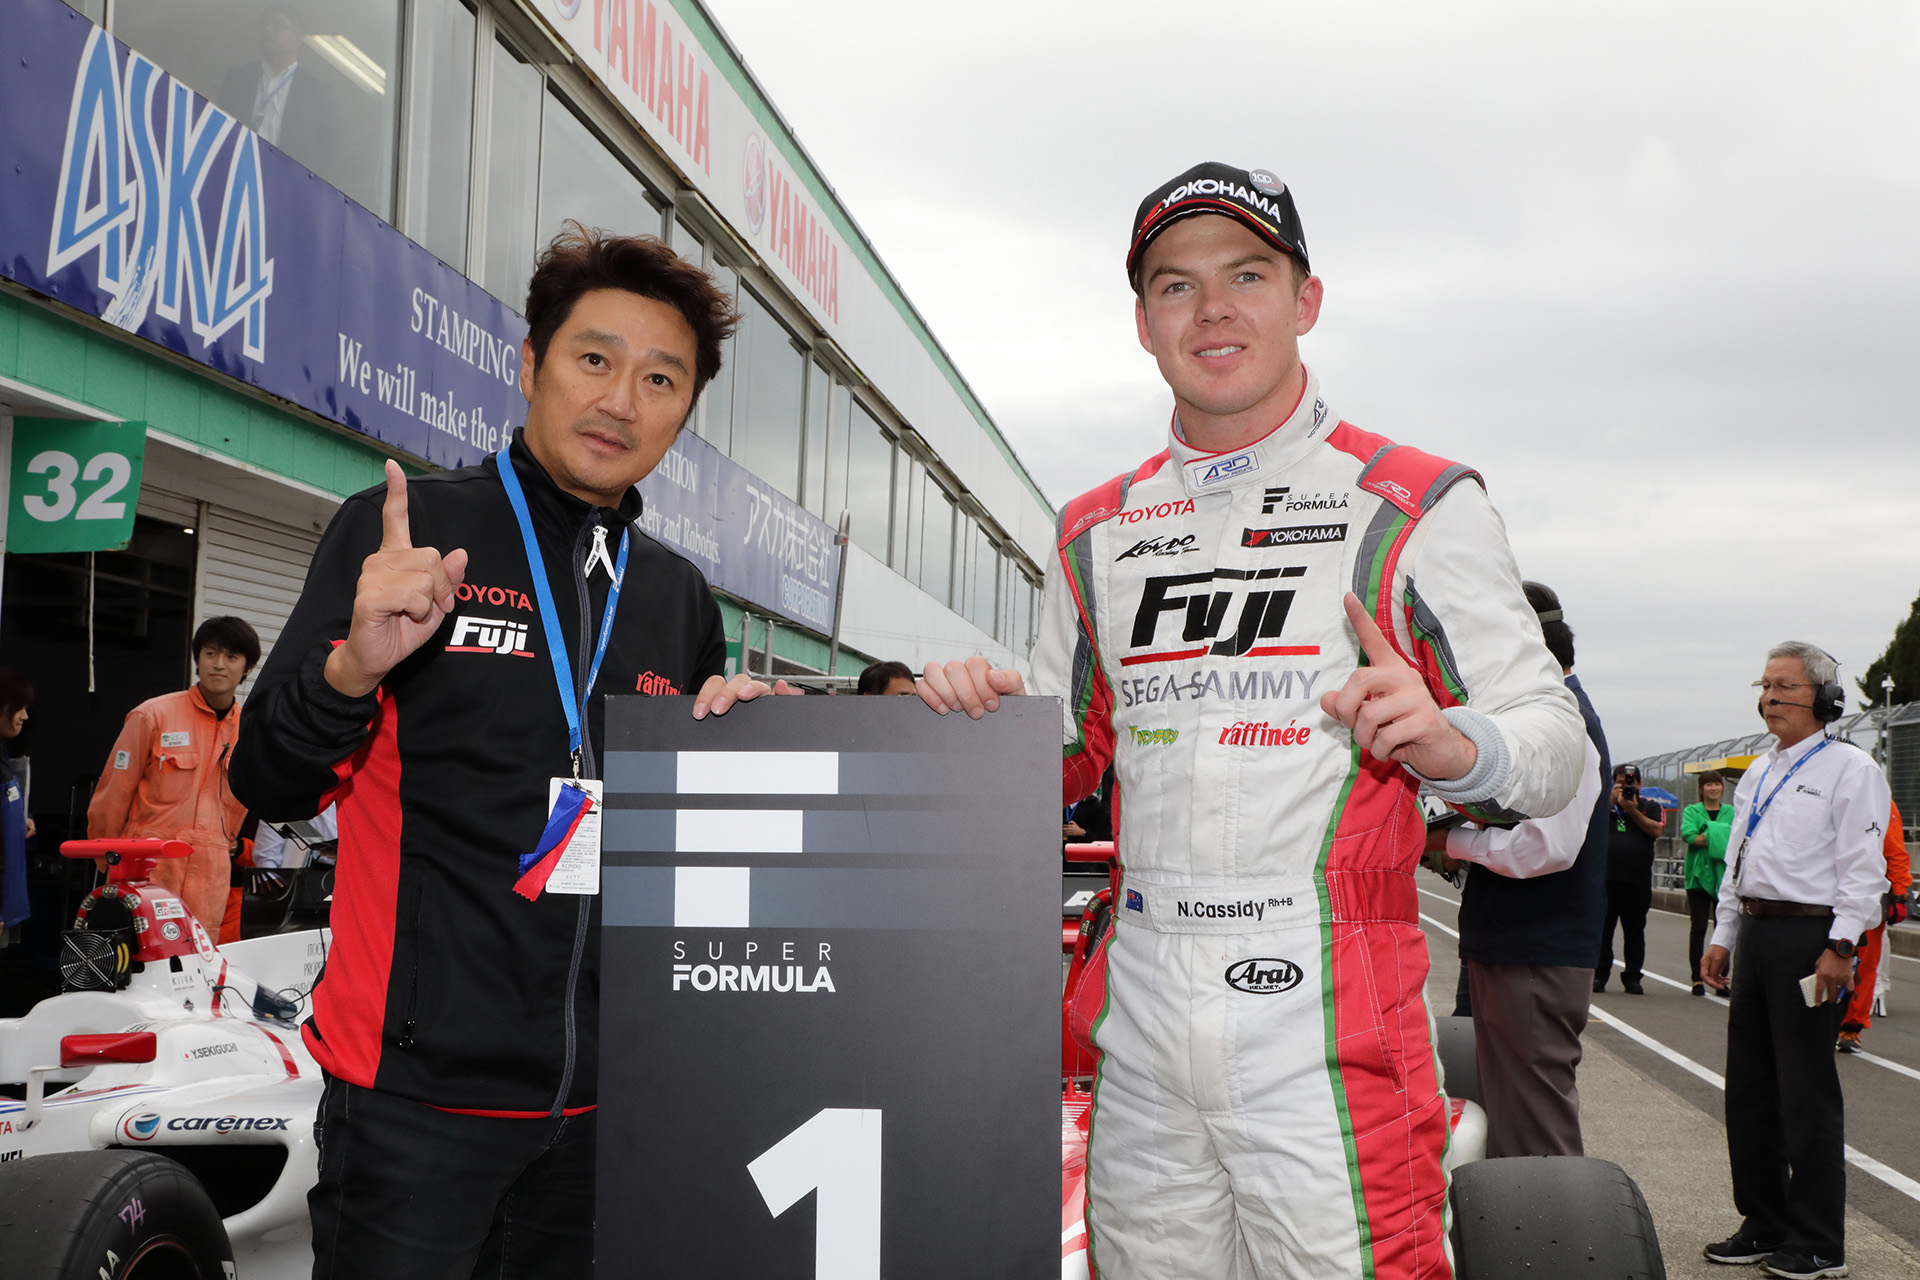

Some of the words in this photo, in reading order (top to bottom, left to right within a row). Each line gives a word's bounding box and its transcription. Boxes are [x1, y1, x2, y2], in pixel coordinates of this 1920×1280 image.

[46, 24, 274, 363] ASKA
[1162, 179, 1282, 224] YOKOHAMA
[769, 159, 838, 325] YAMAHA
[411, 287, 516, 386] STAMPING
[338, 332, 371, 395] We
[376, 363, 415, 416] will
[419, 391, 467, 442] make
[471, 407, 498, 453] the
[23, 449, 132, 522] 32
[1287, 492, 1350, 501] SUPER
[1118, 499, 1195, 525] TOYOTA
[1286, 499, 1348, 512] FORMULA
[664, 514, 681, 545] and
[1270, 527, 1342, 543] YOKOHAMA
[455, 583, 534, 612] OYOTA
[782, 574, 829, 627] CORPORATION
[1130, 566, 1308, 656] Fuji
[450, 616, 528, 654] Fuji
[636, 671, 683, 695] raffin
[1121, 674, 1181, 708] SEGA
[1190, 669, 1321, 700] SAMMY
[1219, 720, 1310, 746] raffinée
[1178, 900, 1265, 921] N.Cassidy
[1268, 898, 1293, 907] Rh+B
[674, 941, 831, 960] SUPER
[673, 965, 836, 993] FORMULA
[1230, 962, 1294, 984] Arai
[191, 1043, 238, 1060] Y.SEKIGUCHI
[167, 1115, 293, 1134] carenex
[746, 1108, 882, 1280] 1
